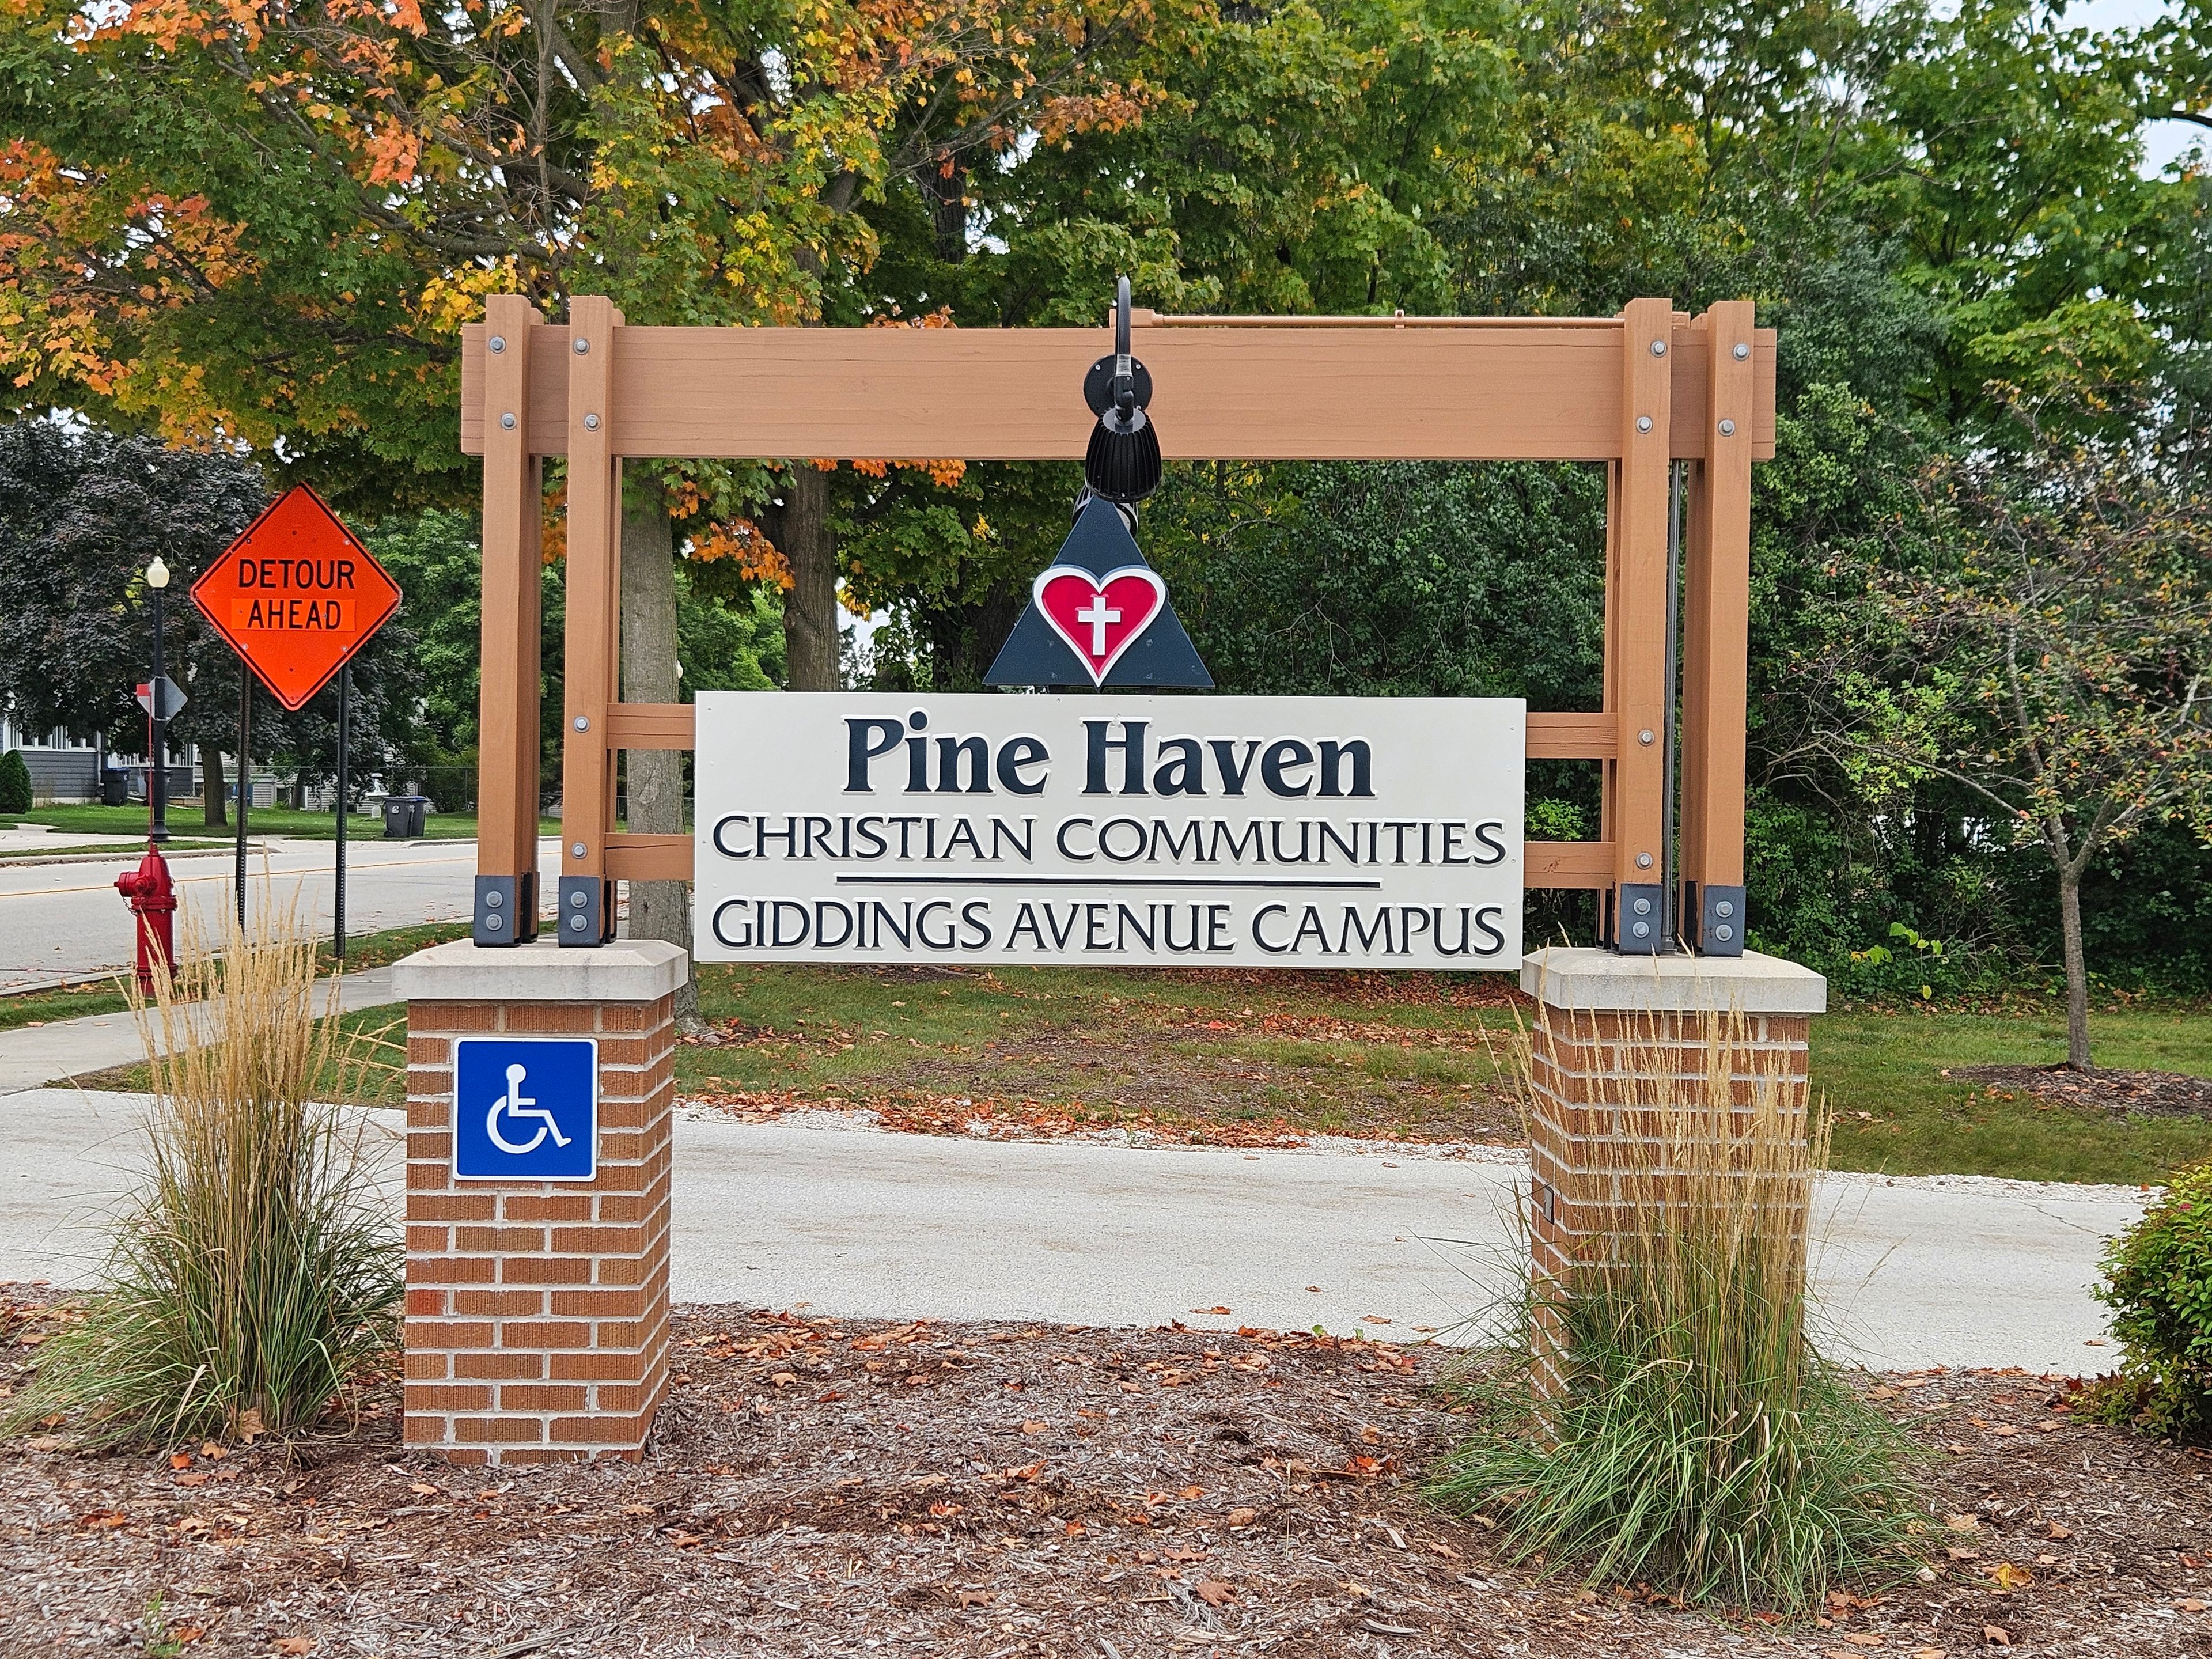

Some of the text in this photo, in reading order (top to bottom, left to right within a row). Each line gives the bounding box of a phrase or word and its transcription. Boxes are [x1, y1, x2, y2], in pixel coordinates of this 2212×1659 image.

[238, 559, 355, 590] DETOUR
[247, 599, 342, 630] AHEAD
[843, 711, 1376, 798] Pine Haven
[713, 815, 1506, 865] CHRISTIAN COMMUNITIES
[711, 899, 1505, 956] GIDDINGS AVENUE CAMPUS
